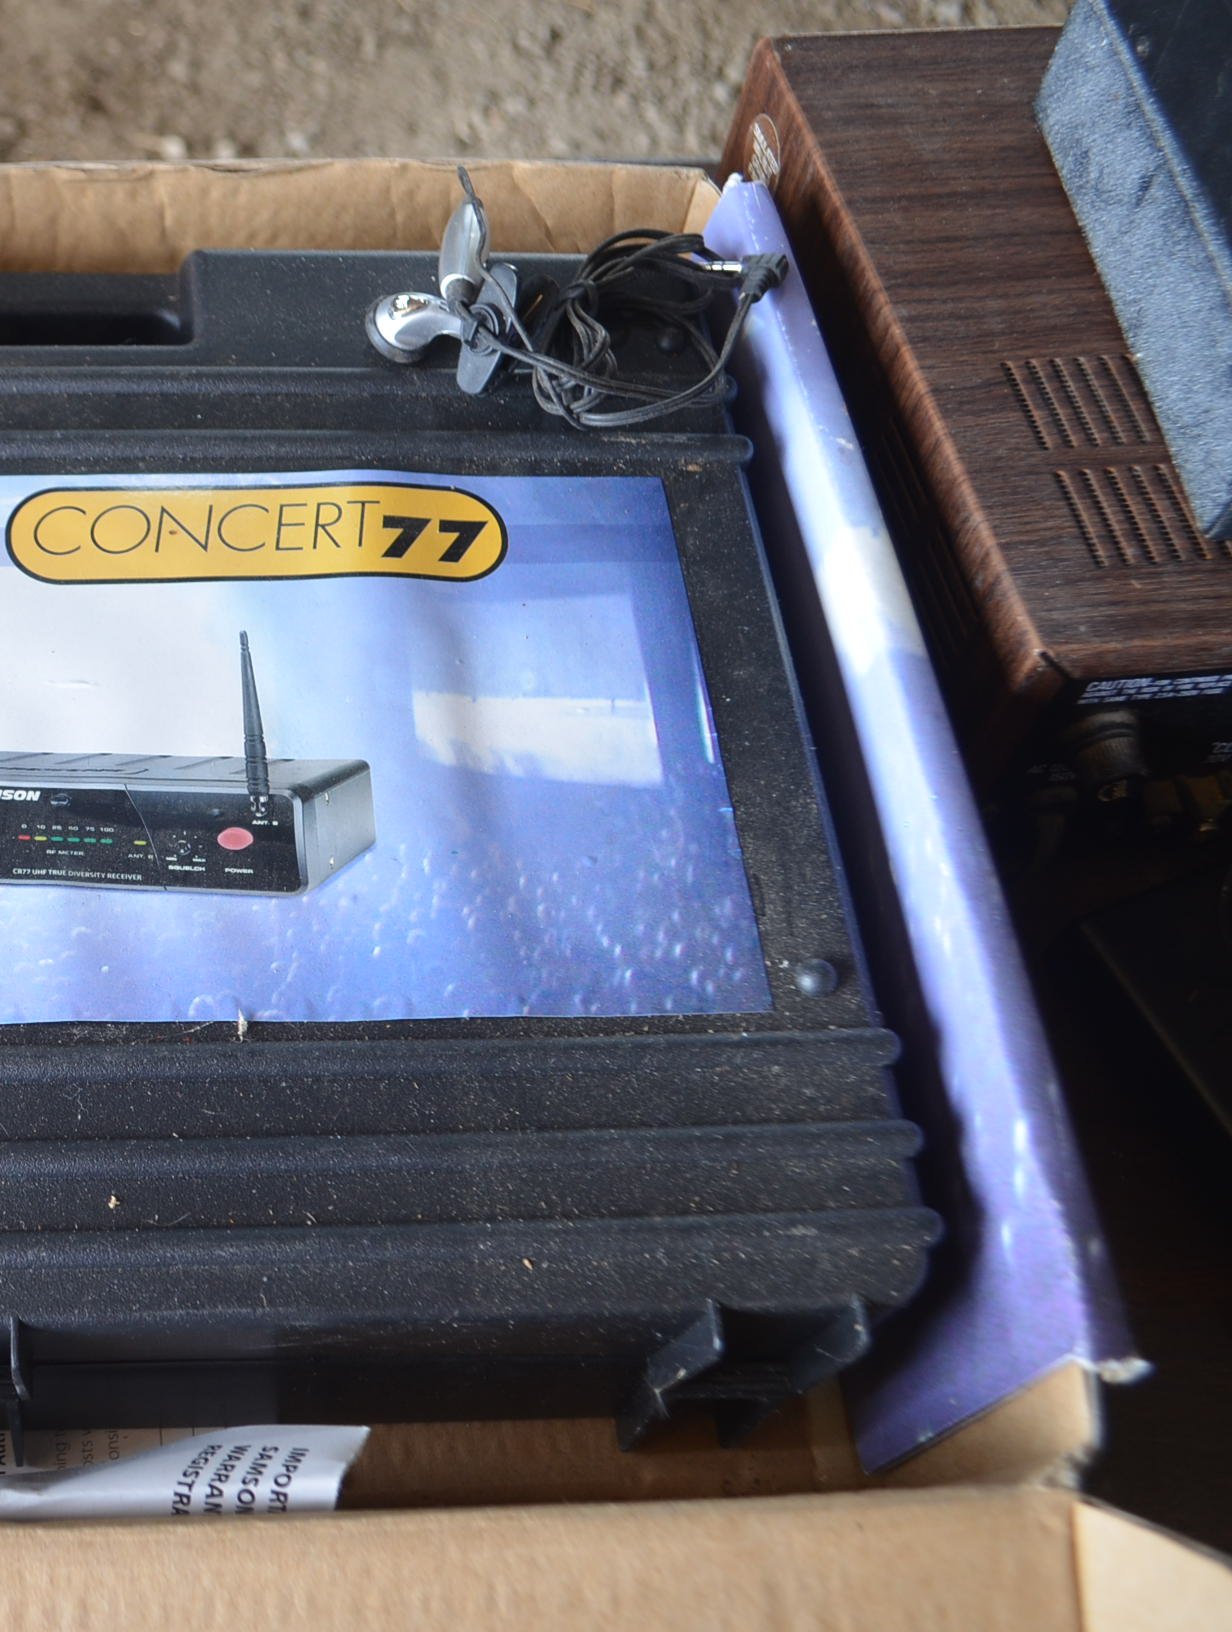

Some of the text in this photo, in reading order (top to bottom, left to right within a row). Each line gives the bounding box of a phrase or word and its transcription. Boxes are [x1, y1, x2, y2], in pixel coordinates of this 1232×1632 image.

[33, 499, 488, 564] CONCERT 77
[67, 870, 106, 879] DIVERSITY
[106, 872, 142, 881] RECEIVER
